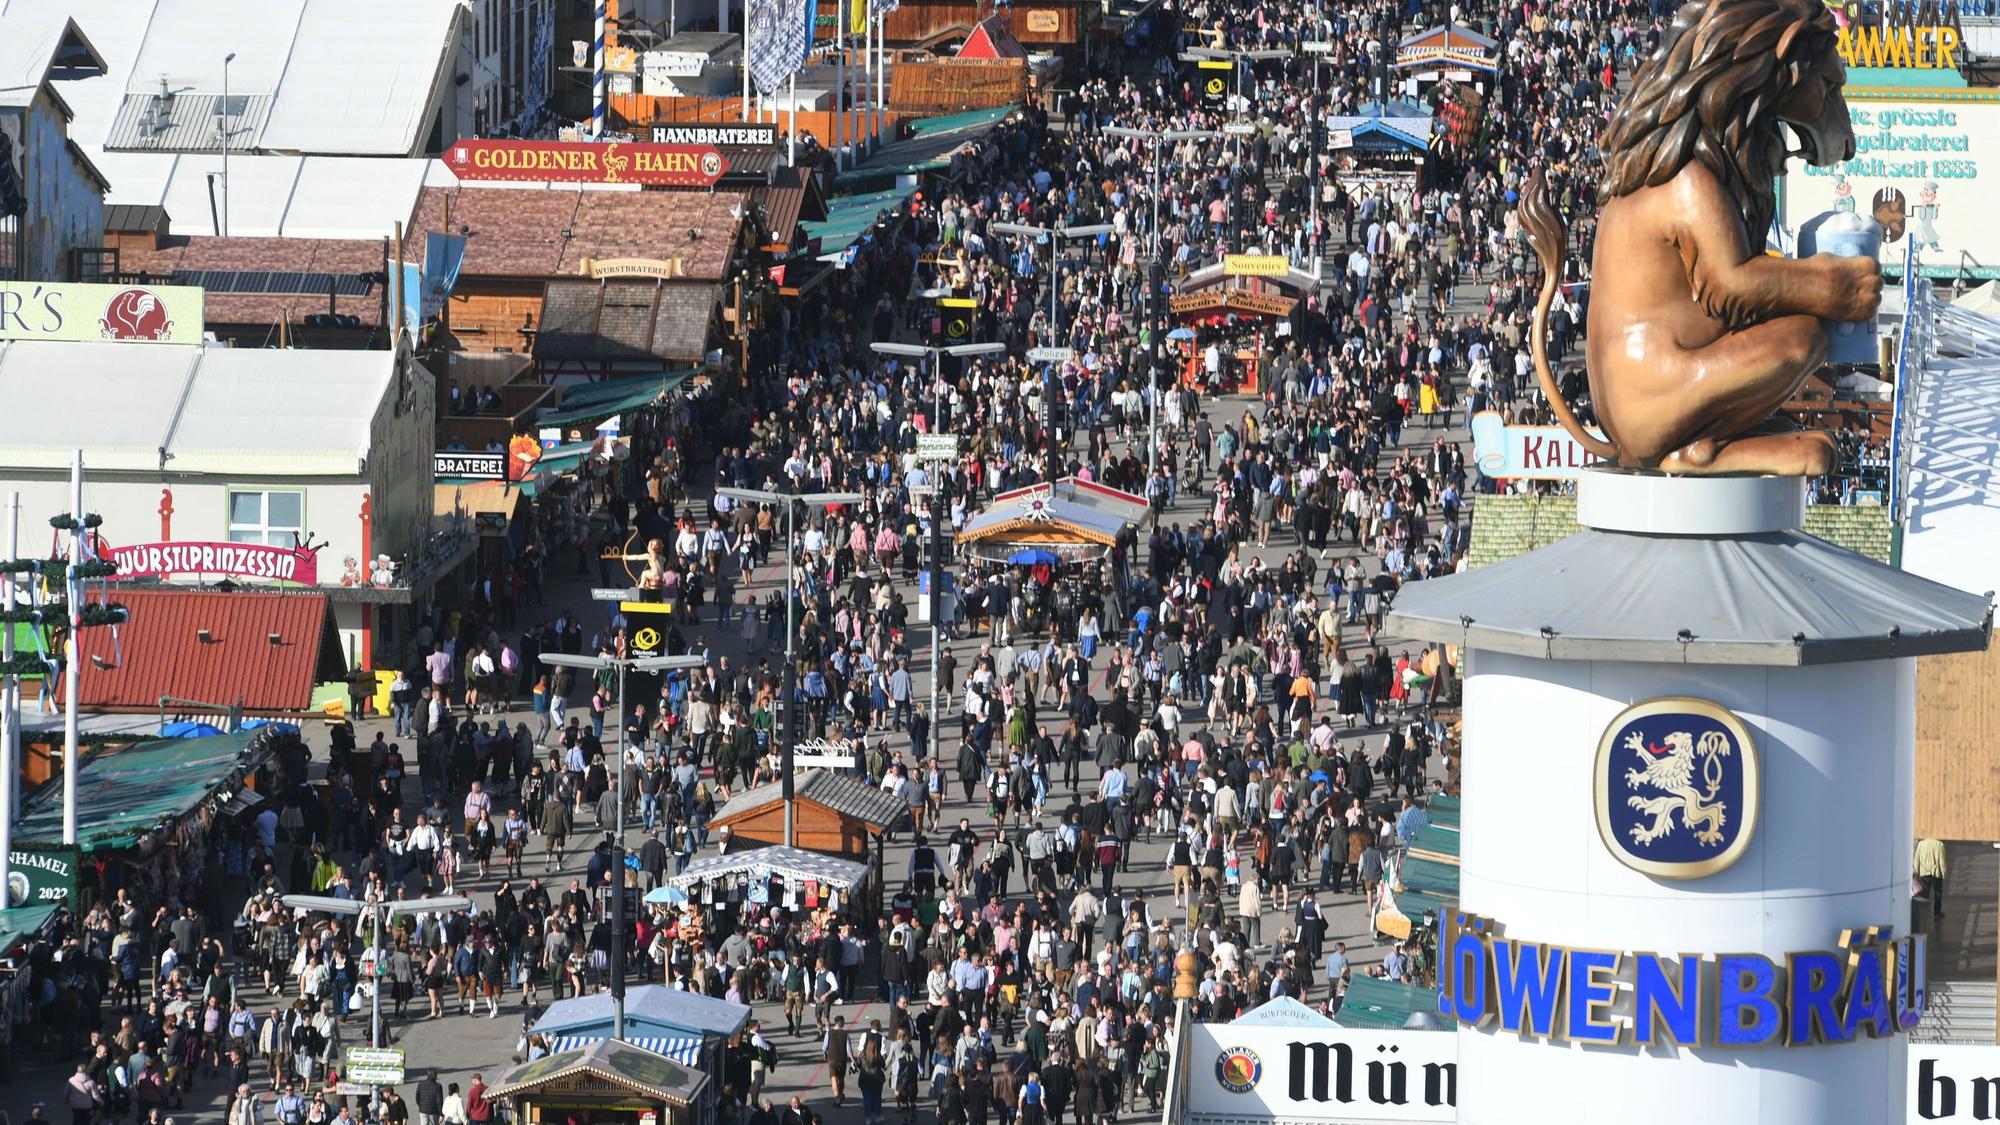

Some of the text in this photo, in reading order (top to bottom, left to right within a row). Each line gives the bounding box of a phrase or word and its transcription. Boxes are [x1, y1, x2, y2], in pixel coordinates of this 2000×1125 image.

[1836, 26, 1959, 69] AMMER
[1878, 107, 1957, 129] grösste
[653, 127, 773, 145] HAXNBRATEREI
[474, 149, 699, 173] GOLDENER HAHN
[1888, 160, 1929, 178] seit
[1933, 159, 1978, 179] 1885
[595, 265, 667, 276] WURSTBRATEREI
[1231, 260, 1281, 271] Souvenirs
[1039, 350, 1068, 358] Polizei
[39, 887, 68, 900] 2022
[1218, 1047, 1260, 1065] PAULANER
